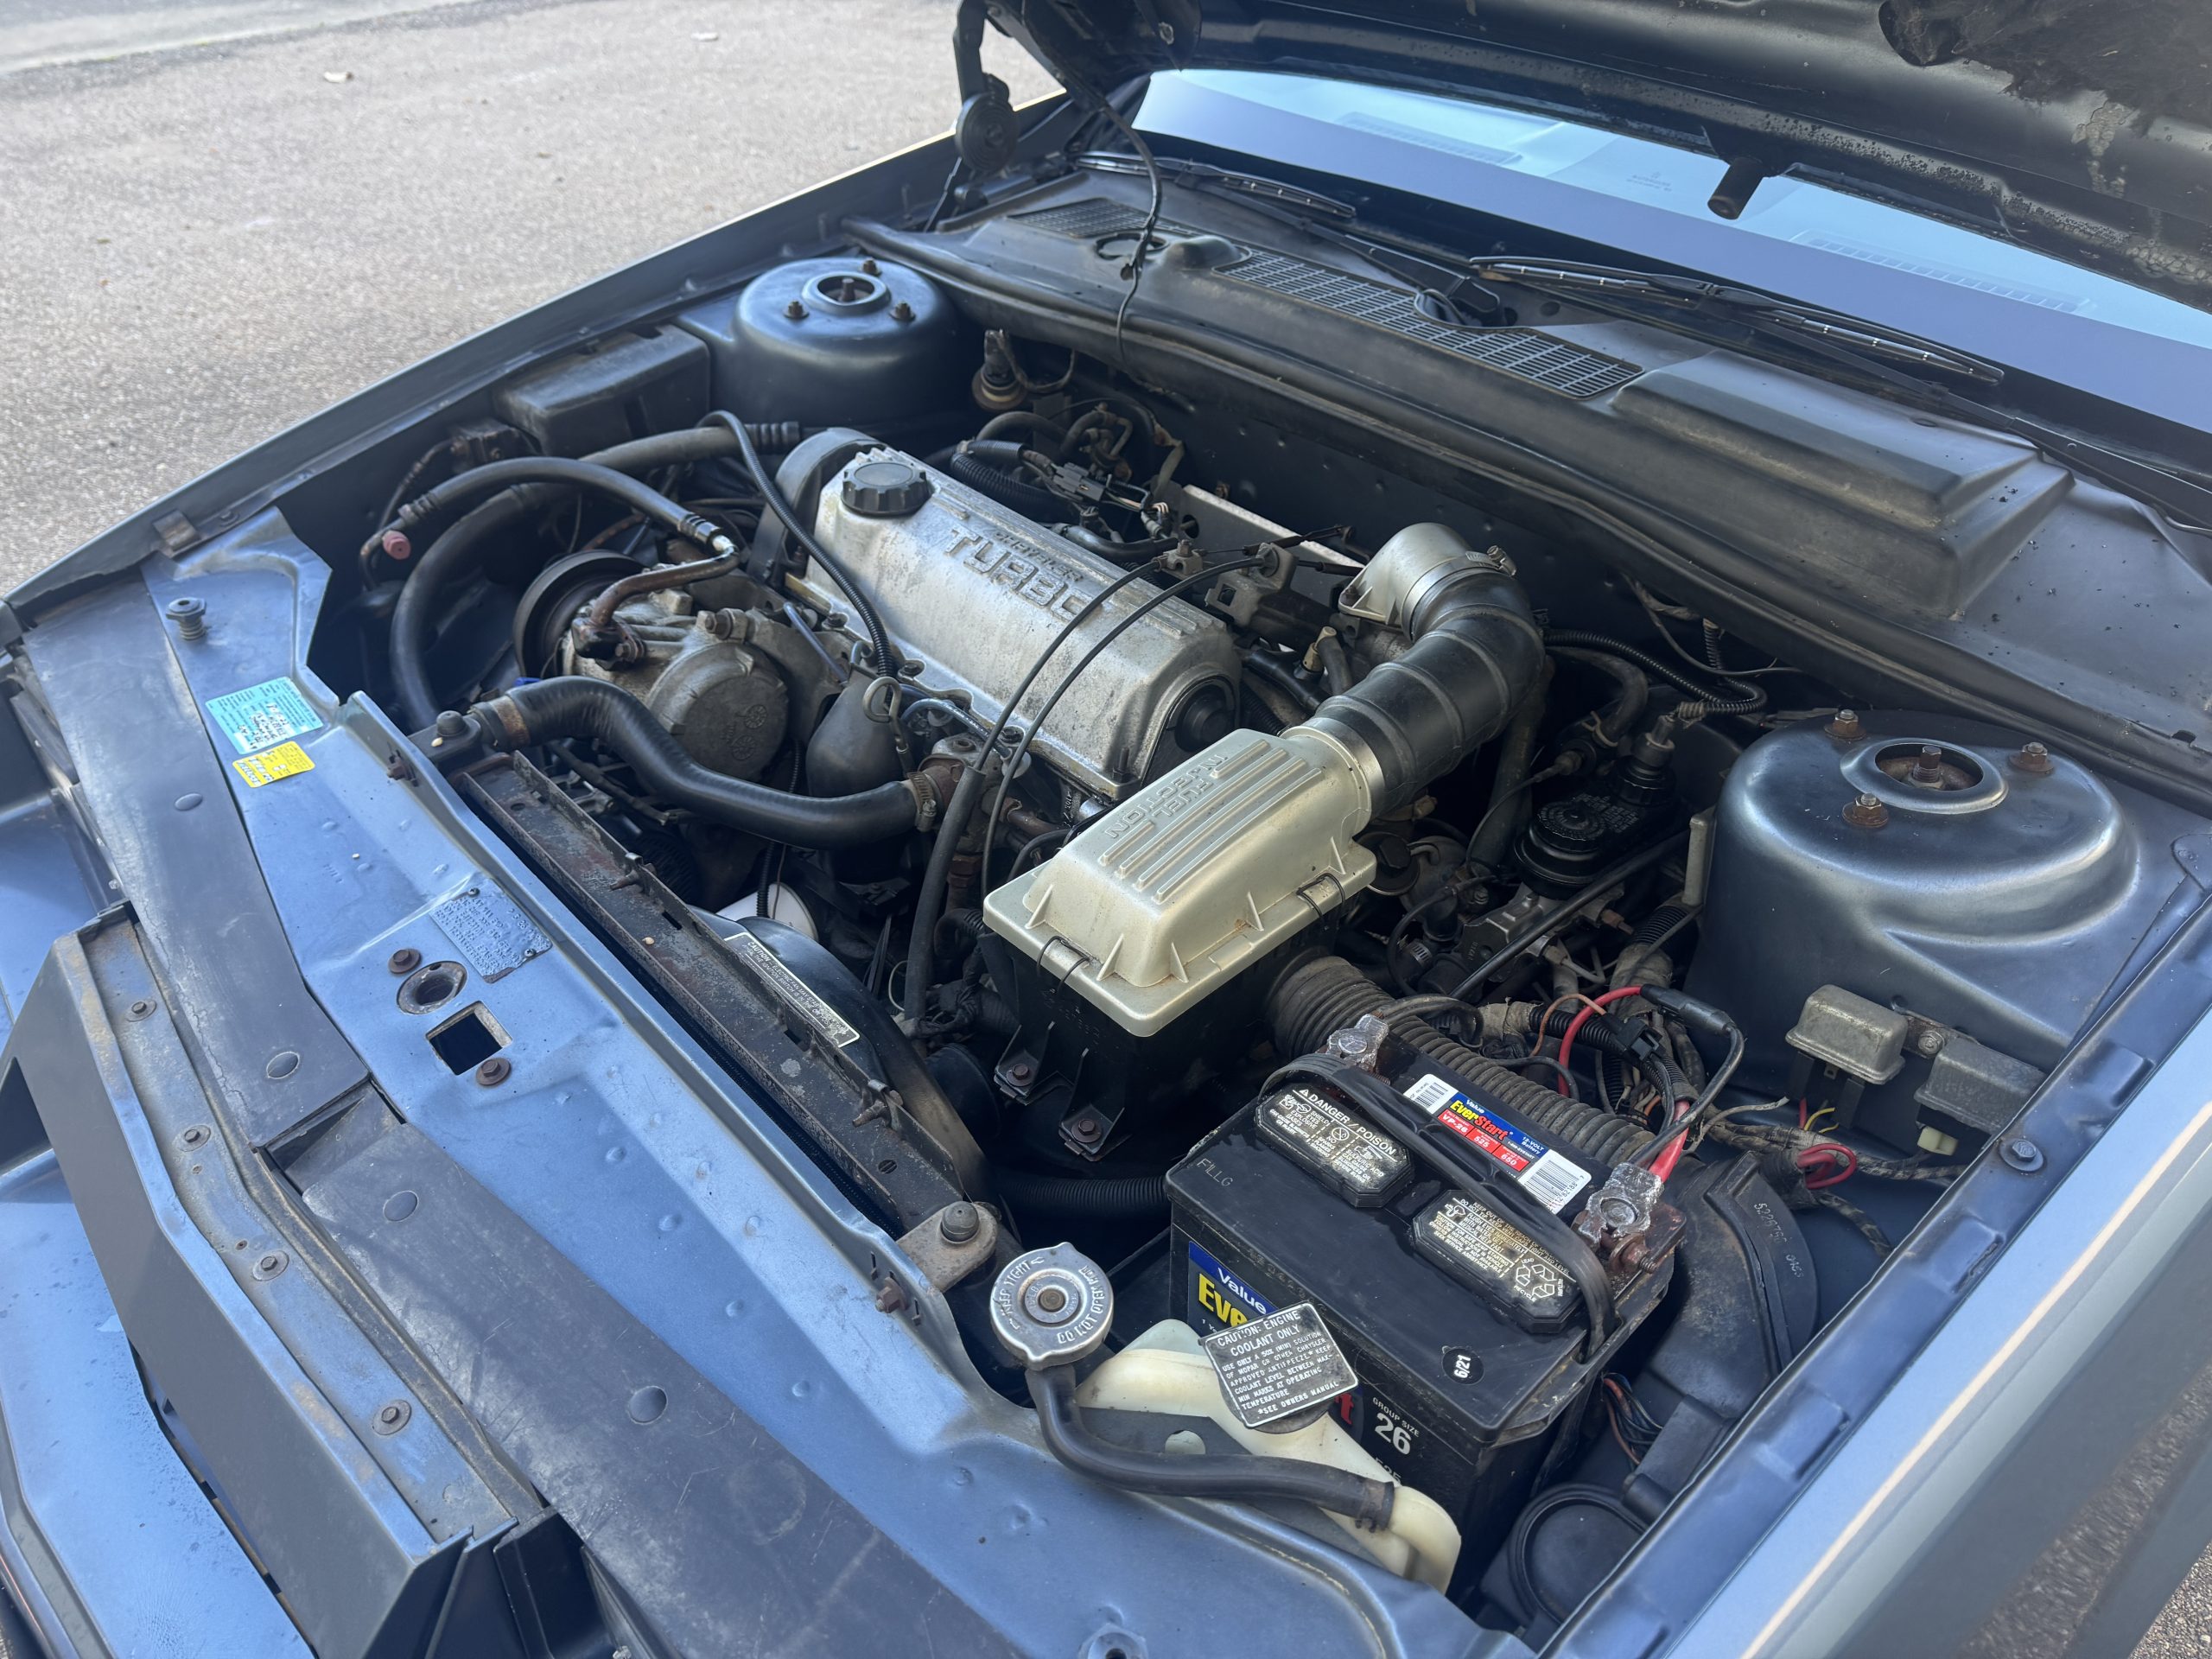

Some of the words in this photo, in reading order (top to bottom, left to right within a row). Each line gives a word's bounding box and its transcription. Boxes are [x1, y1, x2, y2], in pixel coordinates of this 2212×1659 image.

[996, 531, 1084, 582] CHRYSLER
[944, 524, 1096, 626] TURBO
[1104, 753, 1229, 839] INJECTION
[1152, 779, 1214, 817] FUEL
[747, 942, 771, 961] CAUTION
[1285, 1114, 1303, 1126] GASES
[1289, 1109, 1318, 1128] EXPLOSIVE
[1306, 1114, 1319, 1124] EYES
[1306, 1094, 1351, 1123] DANGER
[1355, 1126, 1397, 1154] POISON
[1310, 1111, 1329, 1123] SHIELD
[1450, 1098, 1509, 1141] EverStart
[1344, 1149, 1372, 1167] SULFURIC
[1370, 1166, 1384, 1177] ACID
[1459, 1220, 1479, 1236] MEDICAL
[1478, 1234, 1491, 1244] HELP
[1491, 1243, 1503, 1253] FAST
[1463, 1217, 1476, 1227] WITH
[1491, 1236, 1503, 1245] GET
[1466, 1212, 1482, 1224] FLUSH
[1481, 1223, 1494, 1232] EYES
[1494, 1230, 1525, 1254] IMMEDIATELY
[1472, 1202, 1486, 1211] KEEP
[1485, 1211, 1497, 1219] OUT
[1515, 1230, 1531, 1243] REACH
[1433, 1218, 1452, 1232] FOLLOW
[1450, 1230, 1480, 1253] INSTRUCTIONS
[1485, 1255, 1503, 1268] VEHICLE
[1445, 1238, 1462, 1252] SERVICE
[1464, 1234, 1476, 1243] SAFE
[1475, 1242, 1488, 1251] JUMP
[1487, 1249, 1509, 1266] STARTING
[1488, 1218, 1502, 1228] KEEP
[1502, 1227, 1515, 1237] VENT
[1515, 1236, 1529, 1246] CAPS
[1528, 1245, 1543, 1256] TIGHT
[1543, 1255, 1554, 1263] AND
[1554, 1262, 1570, 1274] LEVEL
[1003, 1260, 1031, 1286] TIGHT
[1217, 1267, 1268, 1315] Value
[1513, 1285, 1537, 1302] RECYCLE
[1057, 1330, 1076, 1344] DO
[1073, 1313, 1097, 1337] NOT
[1090, 1287, 1105, 1314] OPEN
[1217, 1324, 1262, 1346] CAUTION:
[1262, 1310, 1300, 1330] ENGINE
[1222, 1363, 1235, 1371] USE
[1236, 1357, 1252, 1366] ONLY
[1275, 1342, 1291, 1351] (MIN)
[1293, 1331, 1321, 1344] SOLUTION
[1230, 1333, 1275, 1357] COOLANT
[1275, 1324, 1300, 1339] ONLY
[1238, 1363, 1258, 1374] MOPAR
[1274, 1350, 1293, 1360] OTHER
[1296, 1338, 1325, 1352] CHRYSLER
[1230, 1370, 1265, 1387] APPROVED
[1315, 1344, 1332, 1354] KEEP
[1234, 1380, 1262, 1395] COOLANT
[1264, 1371, 1284, 1383] LEVEL
[1287, 1360, 1314, 1375] BETWEEN
[1453, 1354, 1471, 1379] 6/21
[1238, 1394, 1250, 1402] MIN
[1253, 1384, 1274, 1397] MARKS
[1286, 1366, 1322, 1384] OPERATING
[1242, 1388, 1289, 1411] TEMPERATURE
[1280, 1391, 1308, 1408] OWNERS
[1310, 1380, 1338, 1395] MANUAL
[1372, 1396, 1401, 1422] GROUP
[1402, 1420, 1421, 1438] SIZE
[1374, 1412, 1412, 1455] 26
